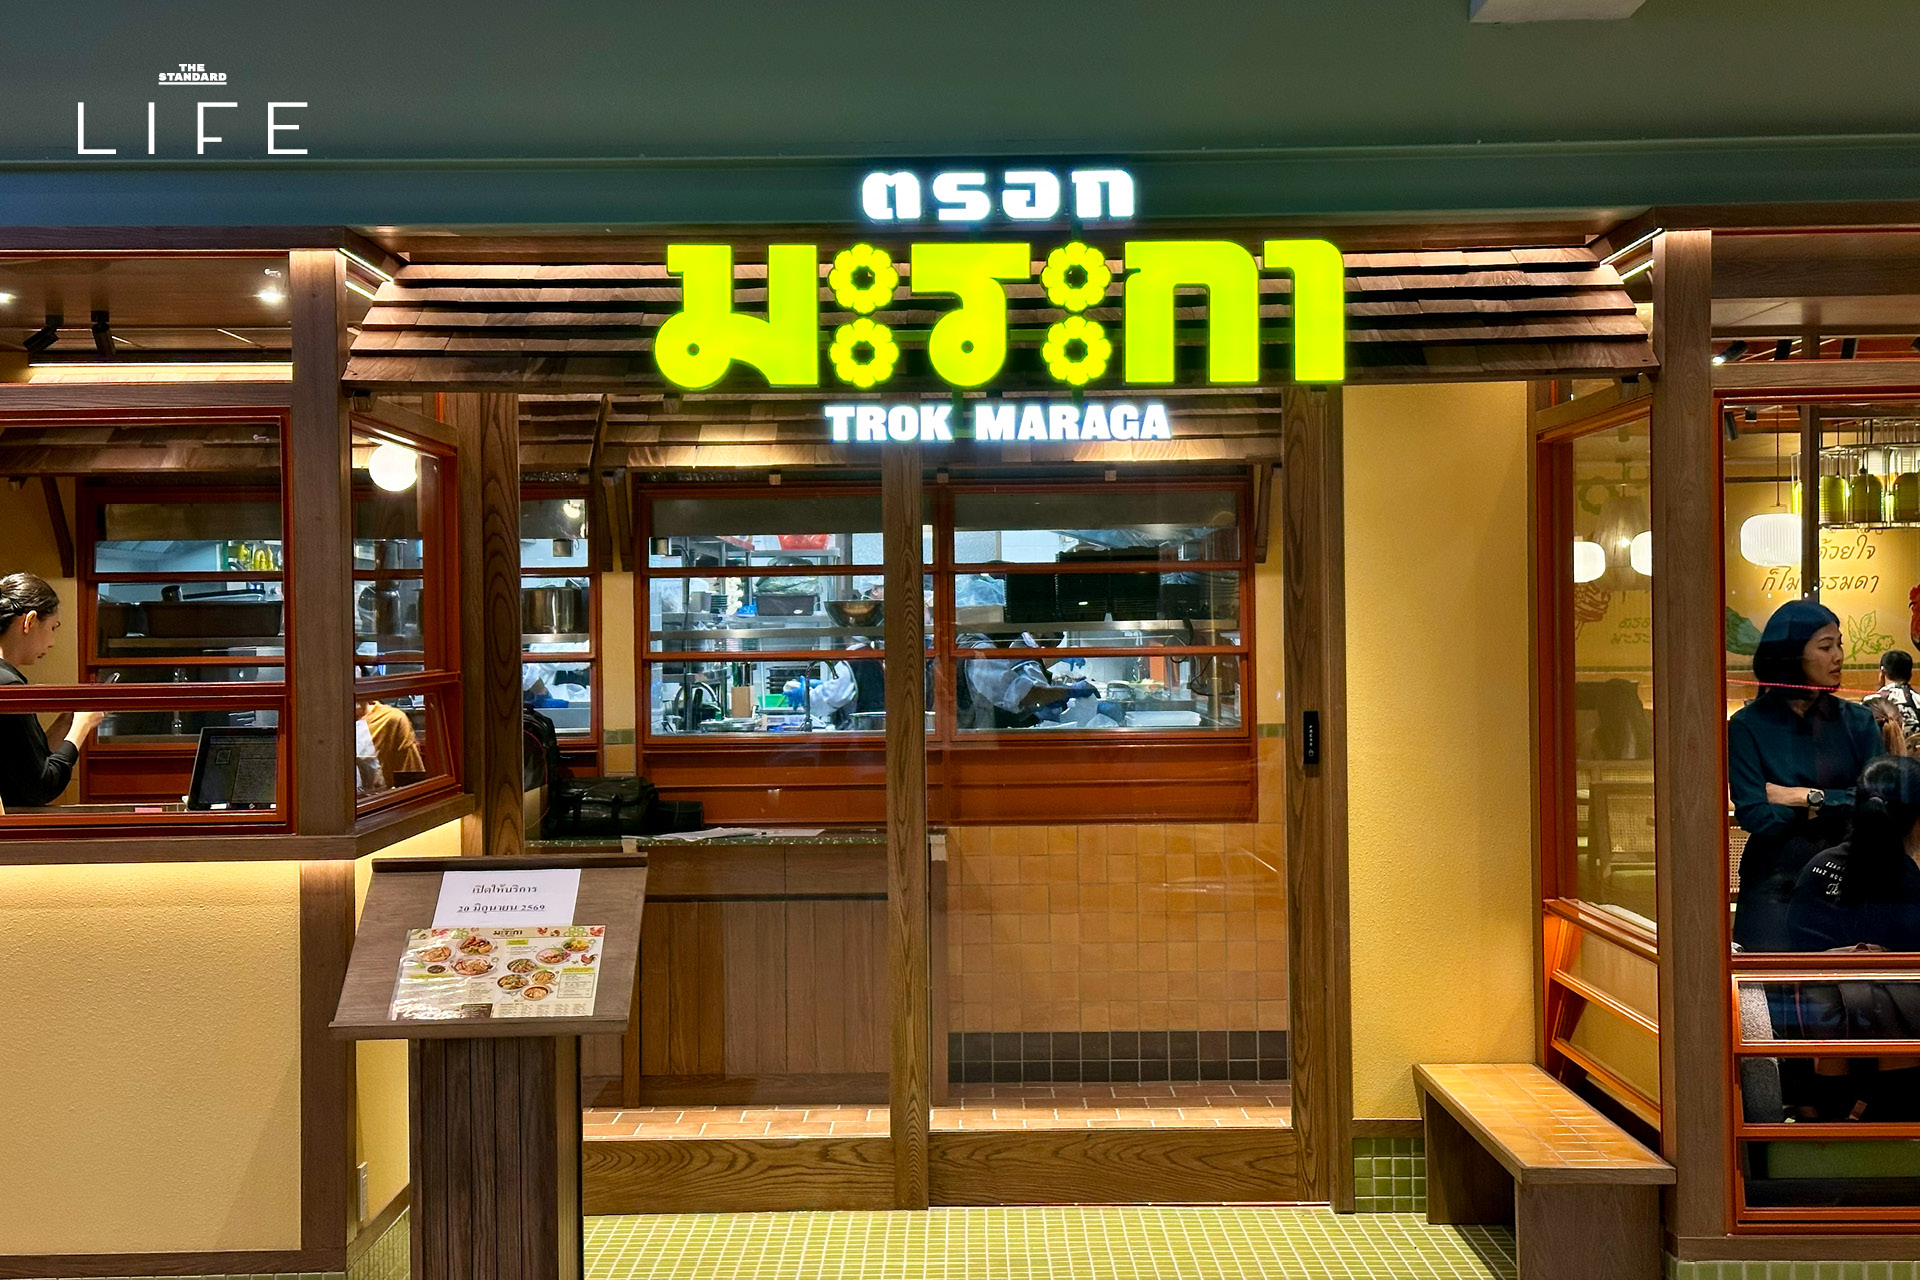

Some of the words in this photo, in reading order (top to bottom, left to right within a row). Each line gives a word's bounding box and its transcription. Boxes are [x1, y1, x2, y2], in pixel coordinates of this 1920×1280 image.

[861, 170, 1135, 221] ตรอก
[653, 239, 1346, 389] มะระกา
[824, 405, 954, 442] TROK
[974, 404, 1173, 442] MARAGA
[472, 883, 538, 894] เปิดให้บริการ
[457, 905, 470, 913] 20
[473, 903, 518, 914] มิถุนายน
[521, 904, 545, 912] 2569
